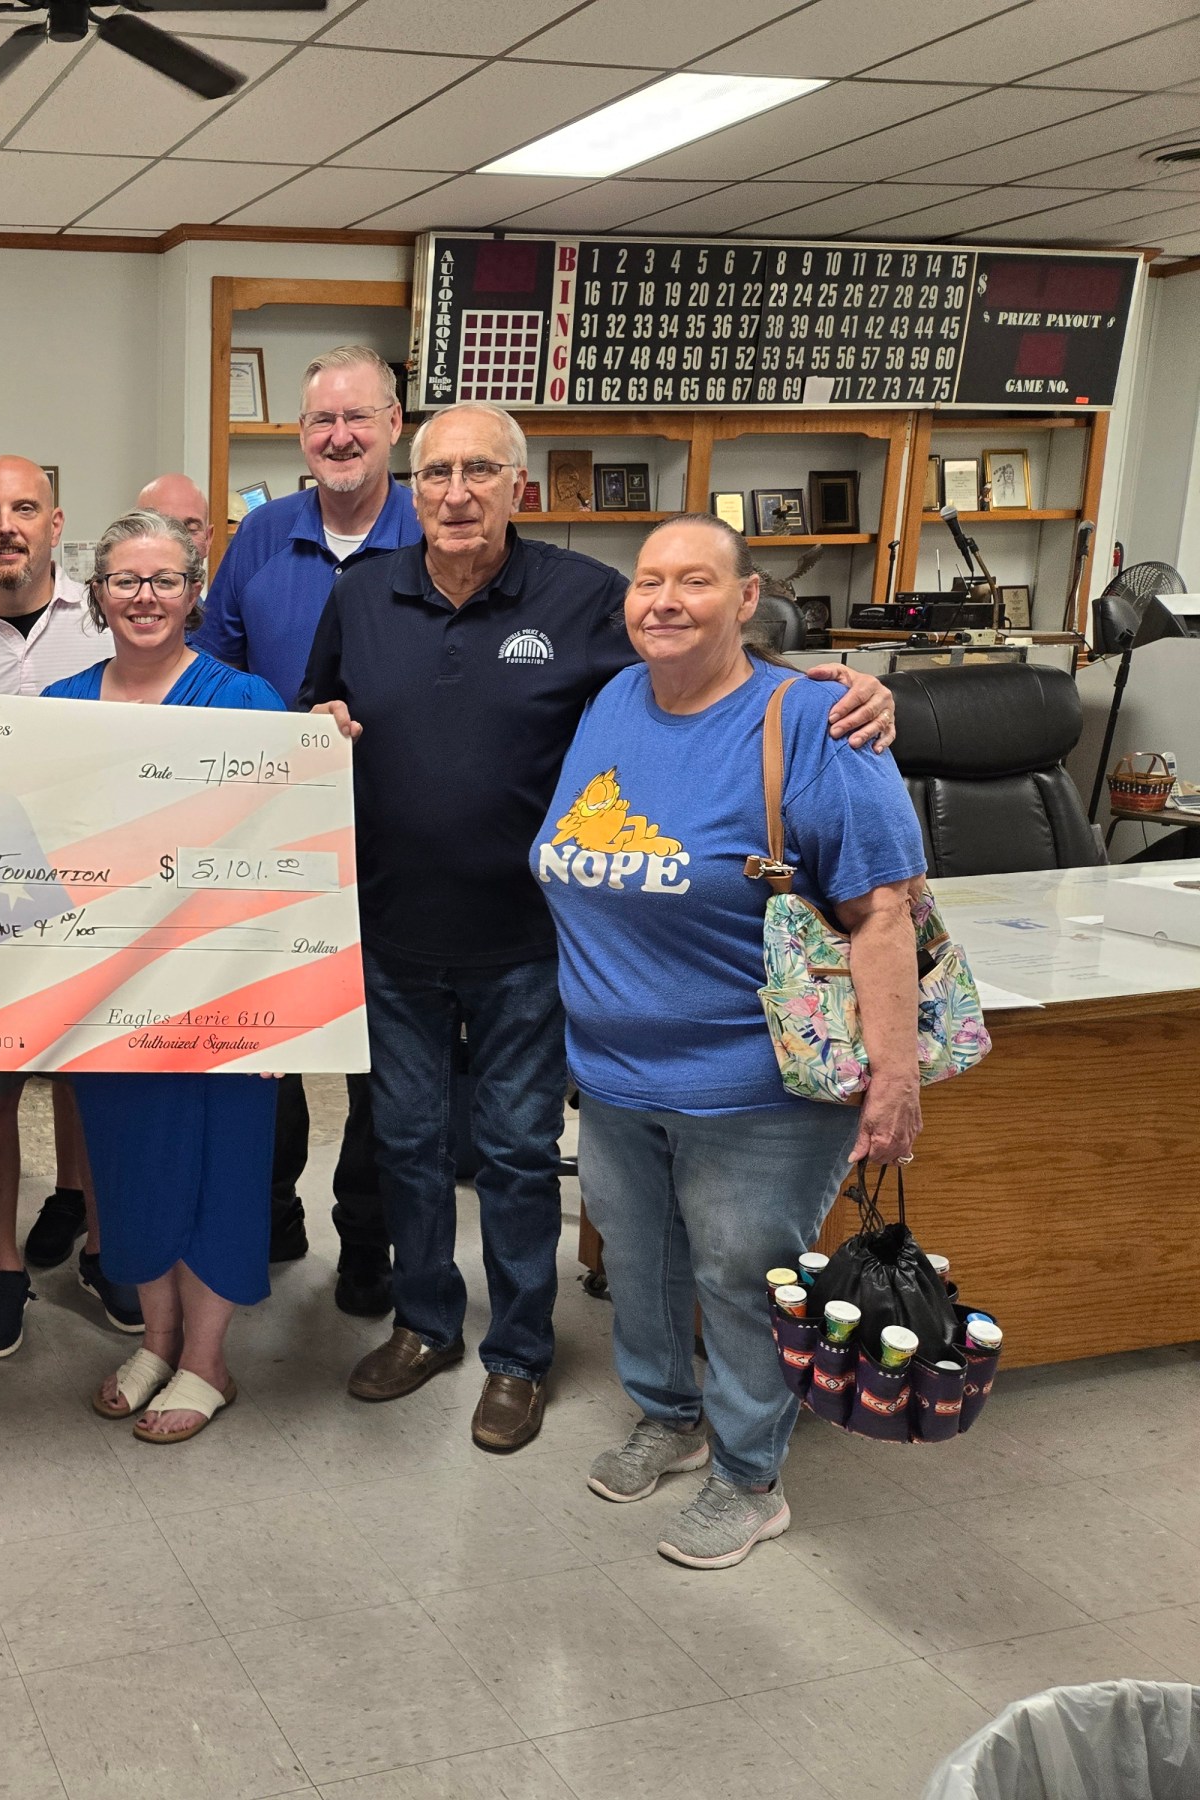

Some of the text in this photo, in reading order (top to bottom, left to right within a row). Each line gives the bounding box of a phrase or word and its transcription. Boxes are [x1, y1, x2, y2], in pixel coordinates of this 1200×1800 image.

[592, 248, 968, 279] 1 2 3 4 5 6 7 8 9 10 11 12 13 14 15
[584, 280, 965, 310] 16 17 18 19 20 21 22 23 24 25 26 27 28 29 30
[433, 250, 455, 376] AUTOTRONIC
[550, 246, 577, 402] BINGO
[997, 311, 1102, 329] PRIZE PAYOUT
[580, 313, 961, 340] 31 32 33 34 35 36 37 38 39 40 41 42 43 44 45
[576, 345, 956, 371] 46 47 48 49 50 51 52 53 54 55 56 57 58 59 60
[432, 383, 453, 392] King
[575, 376, 952, 402] 61 62 63 64 65 66 67 68 69 71 72 73 74 75
[1005, 379, 1070, 393] GAME NO.
[301, 734, 330, 749] 610
[138, 762, 173, 780] Date
[199, 750, 291, 787] 7/20/24
[159, 854, 176, 884] $
[538, 843, 691, 895] NOPE
[290, 938, 339, 955] Dollars
[105, 1008, 275, 1029] Eagles Aerie 610
[127, 1032, 260, 1053] Authorized Signature
